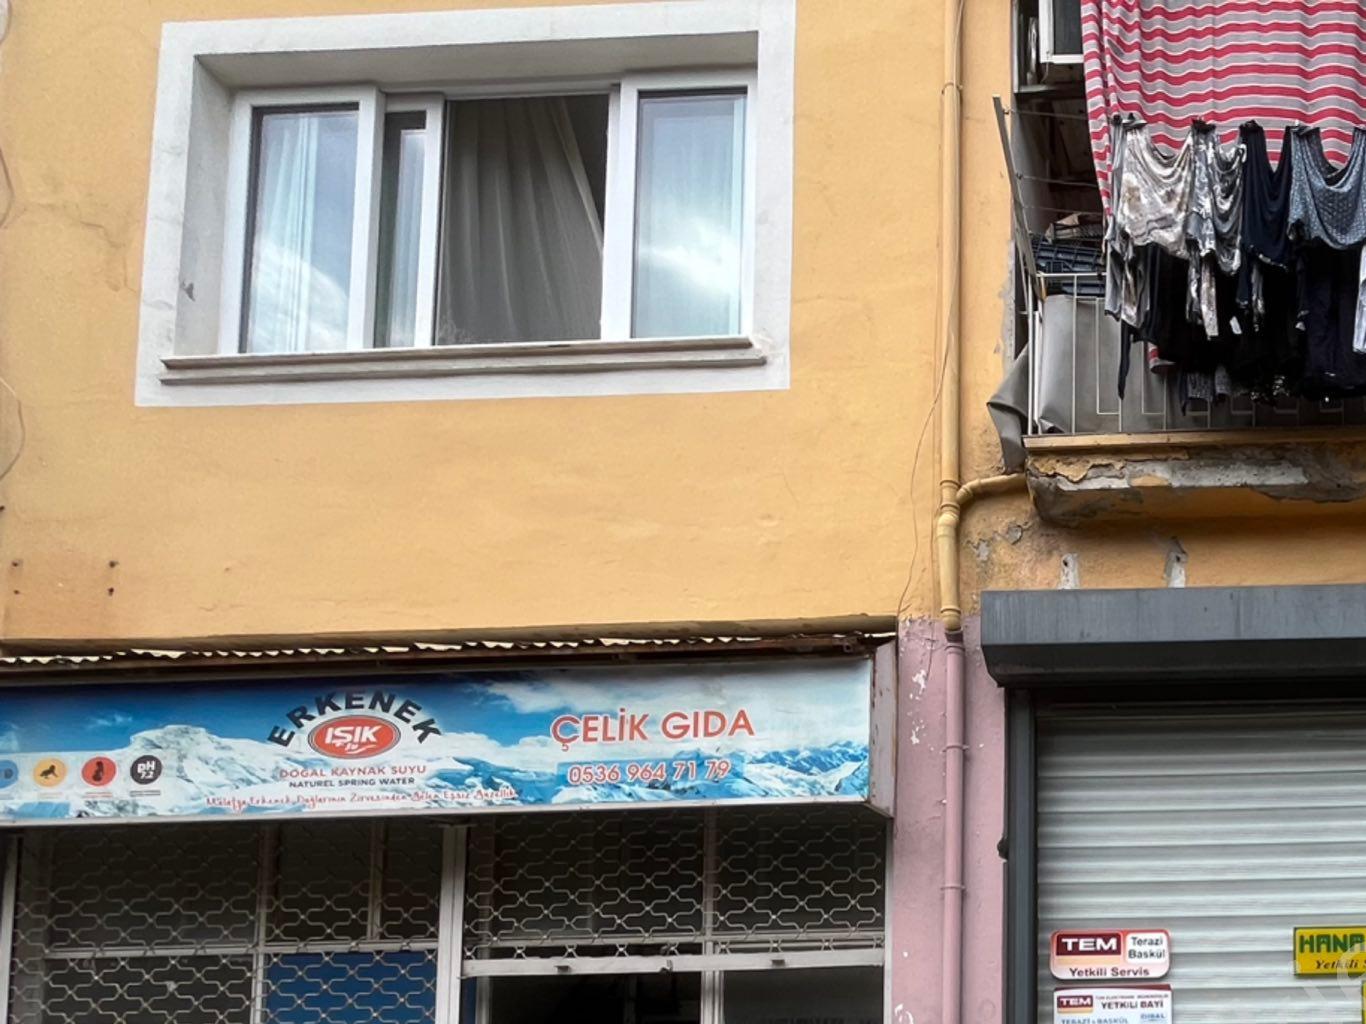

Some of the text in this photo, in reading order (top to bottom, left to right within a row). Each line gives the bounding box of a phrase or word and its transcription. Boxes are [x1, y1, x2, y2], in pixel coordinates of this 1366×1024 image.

[266, 691, 442, 748] ERKENEK
[552, 708, 755, 751] ÇELİK GIDA
[325, 726, 382, 747] IŞIK
[137, 761, 156, 774] pH
[280, 765, 427, 778] DOĞAL KAYNAK SUYU
[568, 760, 731, 784] 0536 964 71 79
[289, 777, 415, 789] NATUREL SPRING WATER
[1061, 938, 1117, 951] TEM
[1130, 937, 1162, 947] Terazi
[1299, 933, 1365, 953] HANA
[1128, 949, 1165, 959] Baskül
[1315, 959, 1359, 970] Yetkili
[1069, 966, 1150, 977] Yetkili Servis
[1061, 997, 1091, 1006] TEM
